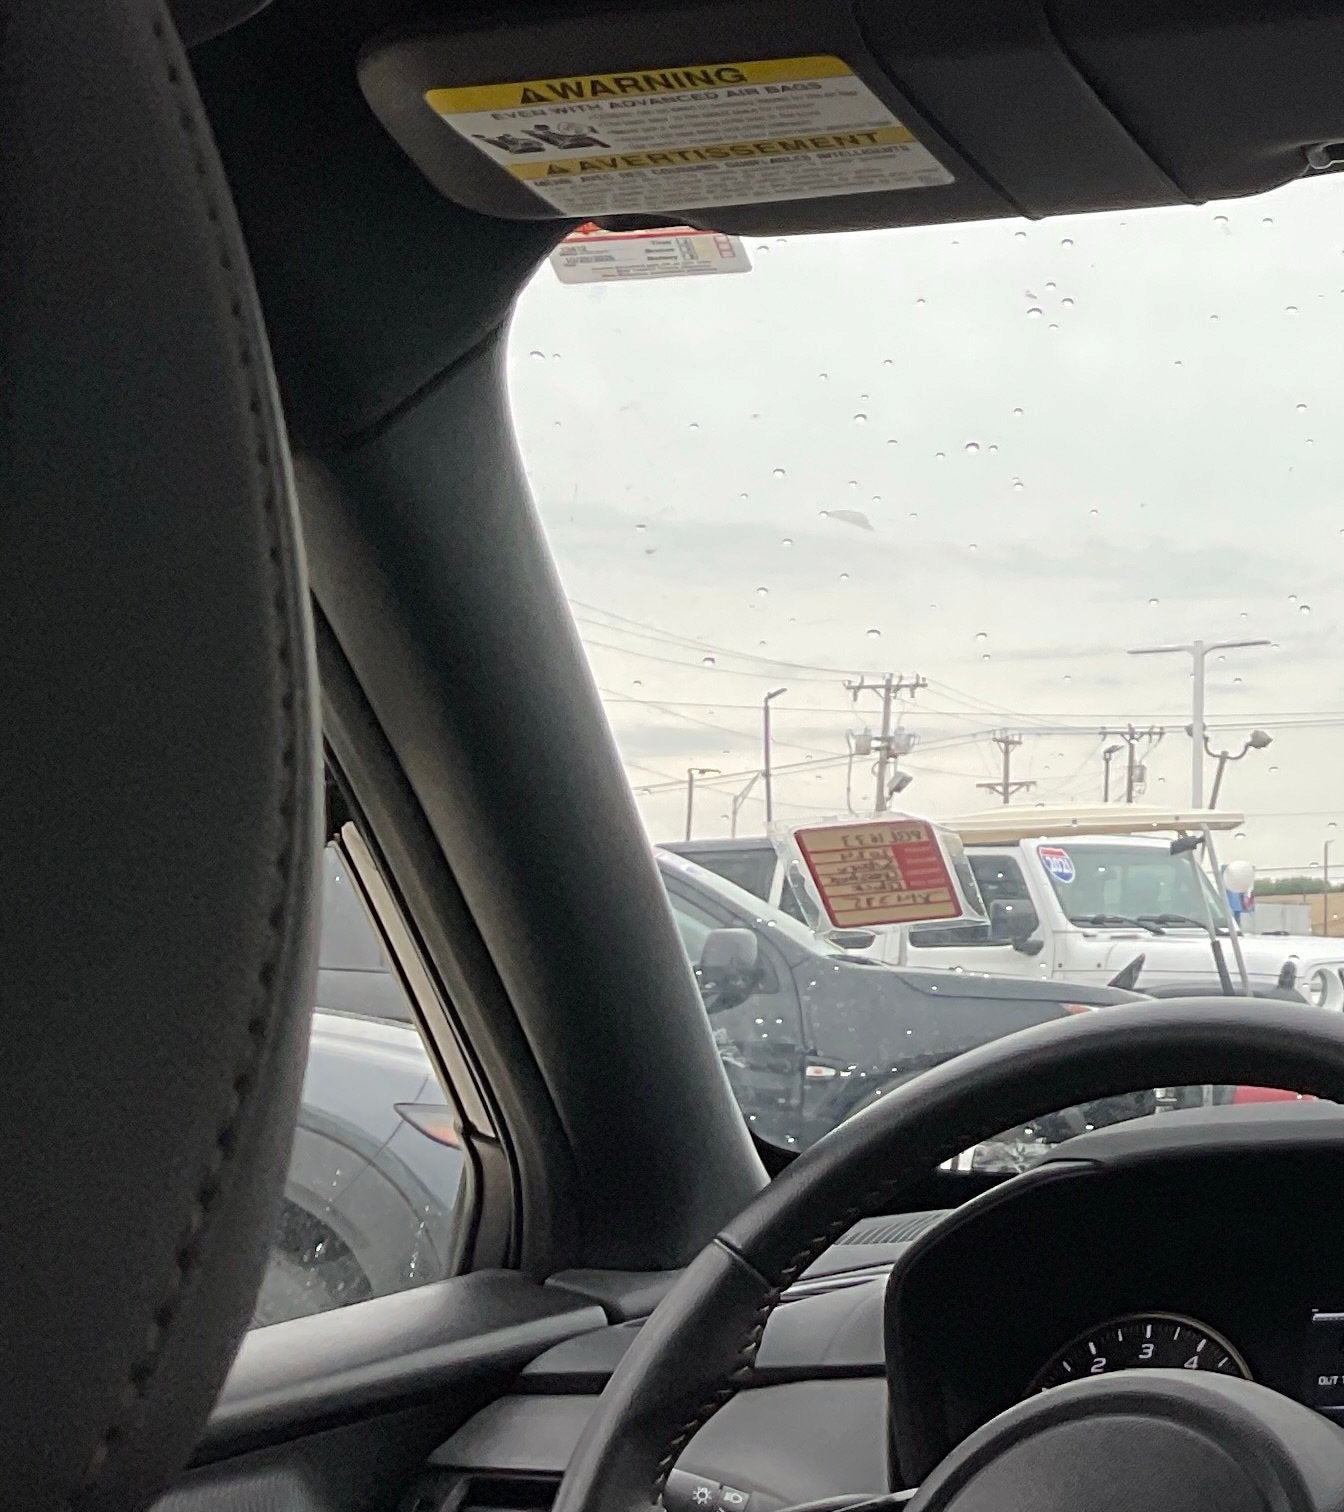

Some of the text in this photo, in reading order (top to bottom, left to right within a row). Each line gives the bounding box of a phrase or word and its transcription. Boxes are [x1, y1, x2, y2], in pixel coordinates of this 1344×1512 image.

[546, 66, 748, 102] WARNING
[487, 81, 826, 120] EVEN WITH ADVANCED AIR BAGS
[578, 131, 883, 170] AVERTISSEMENT
[1138, 1343, 1154, 1359] 3
[1090, 1357, 1107, 1373] 2
[1183, 1356, 1199, 1370] 4
[1318, 1375, 1338, 1386] OUT
